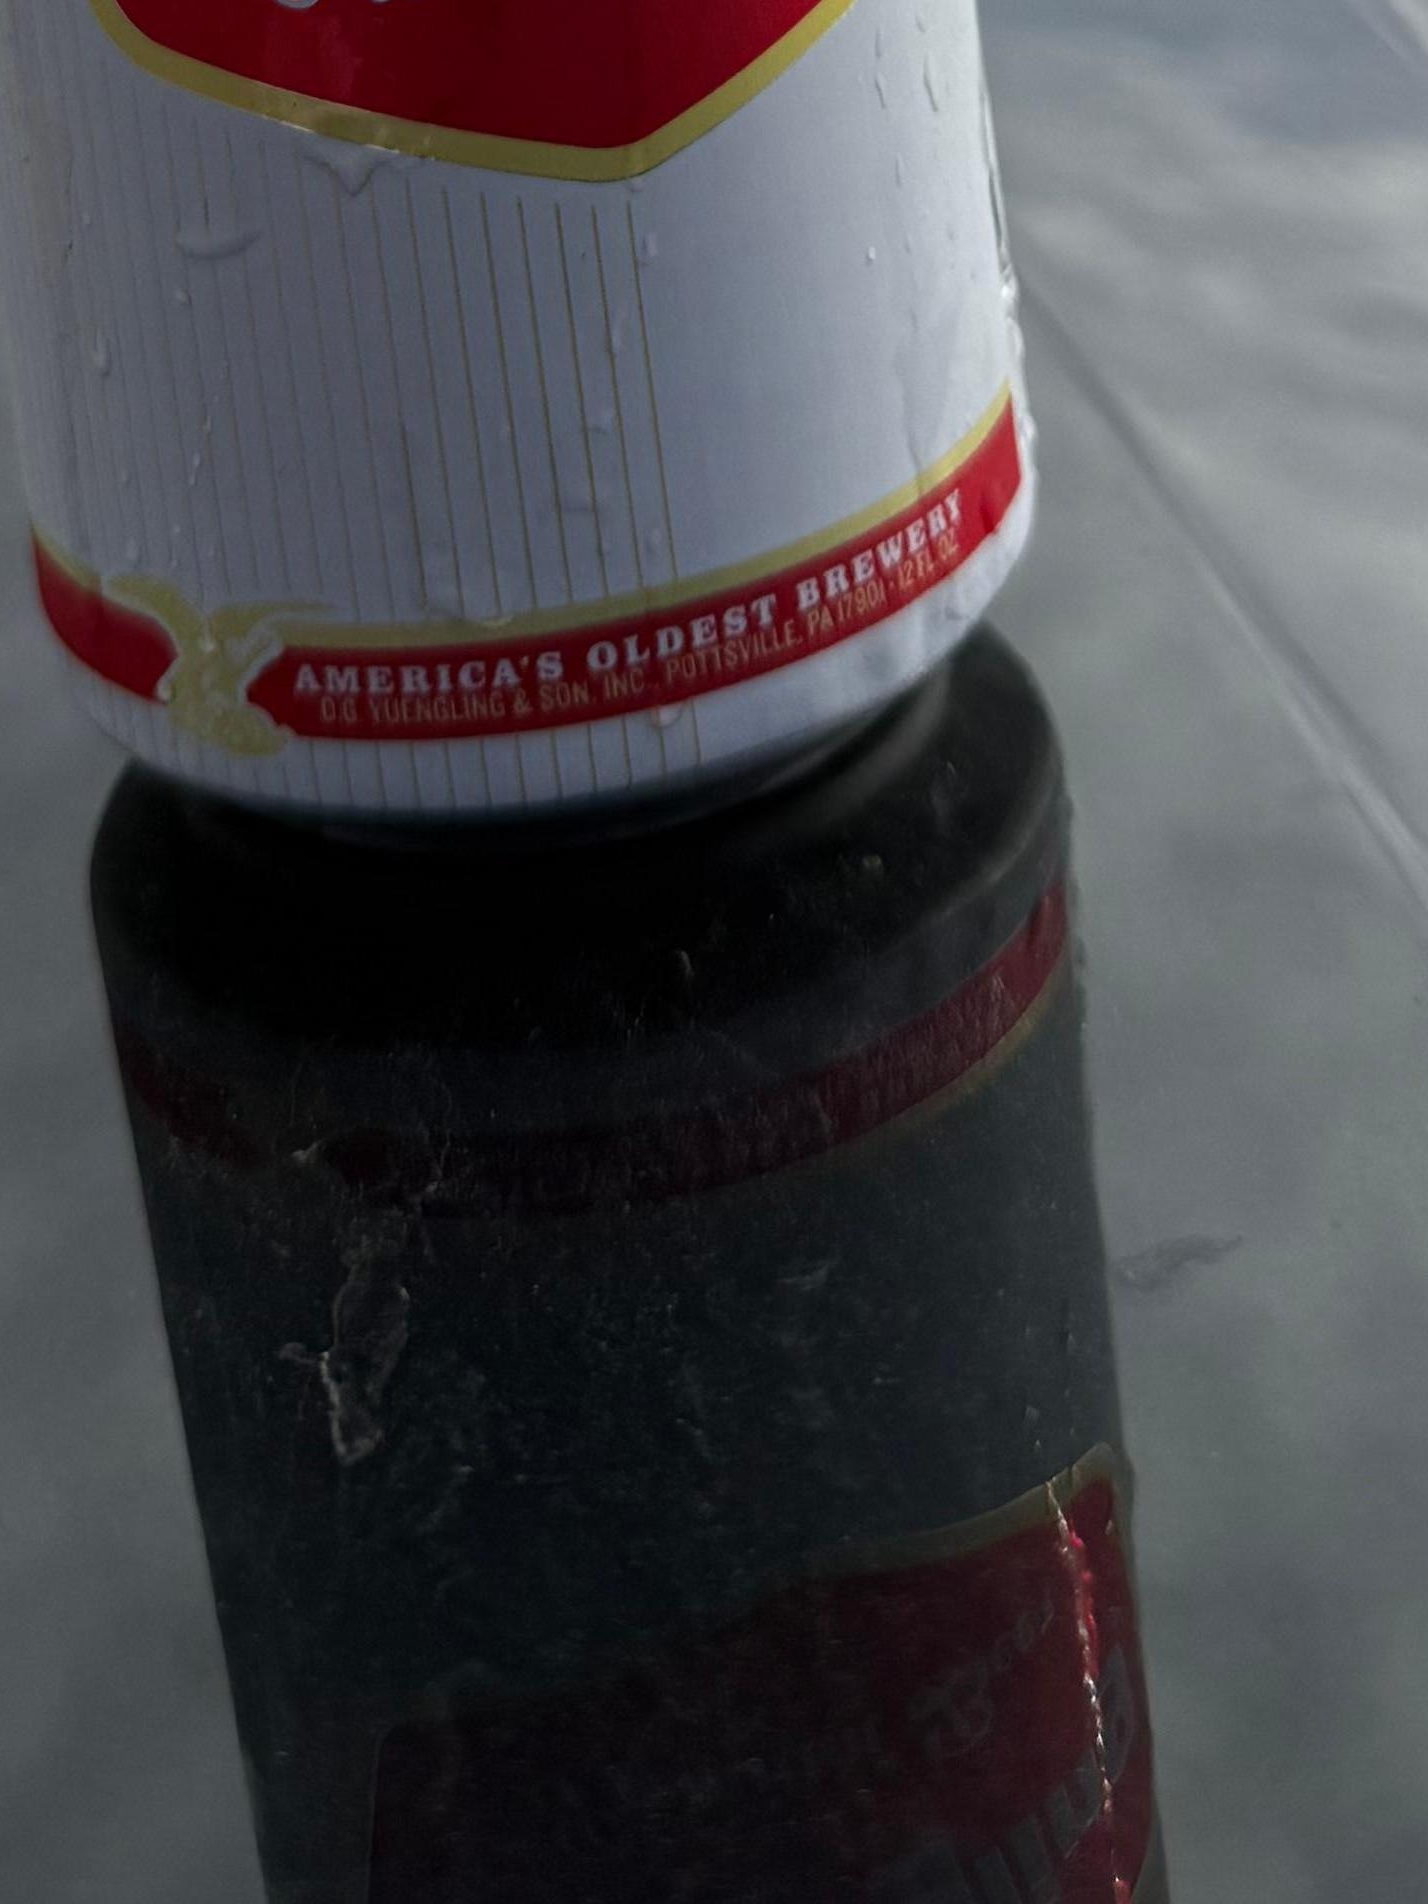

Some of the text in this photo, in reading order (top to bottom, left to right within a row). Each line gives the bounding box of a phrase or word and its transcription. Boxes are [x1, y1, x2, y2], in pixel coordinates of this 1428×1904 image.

[294, 488, 960, 695] AMERICA'S OLDEST BREWERY
[372, 690, 506, 725] YUENGLING
[513, 688, 532, 716] &
[806, 605, 835, 637] PA
[897, 557, 915, 592] 12
